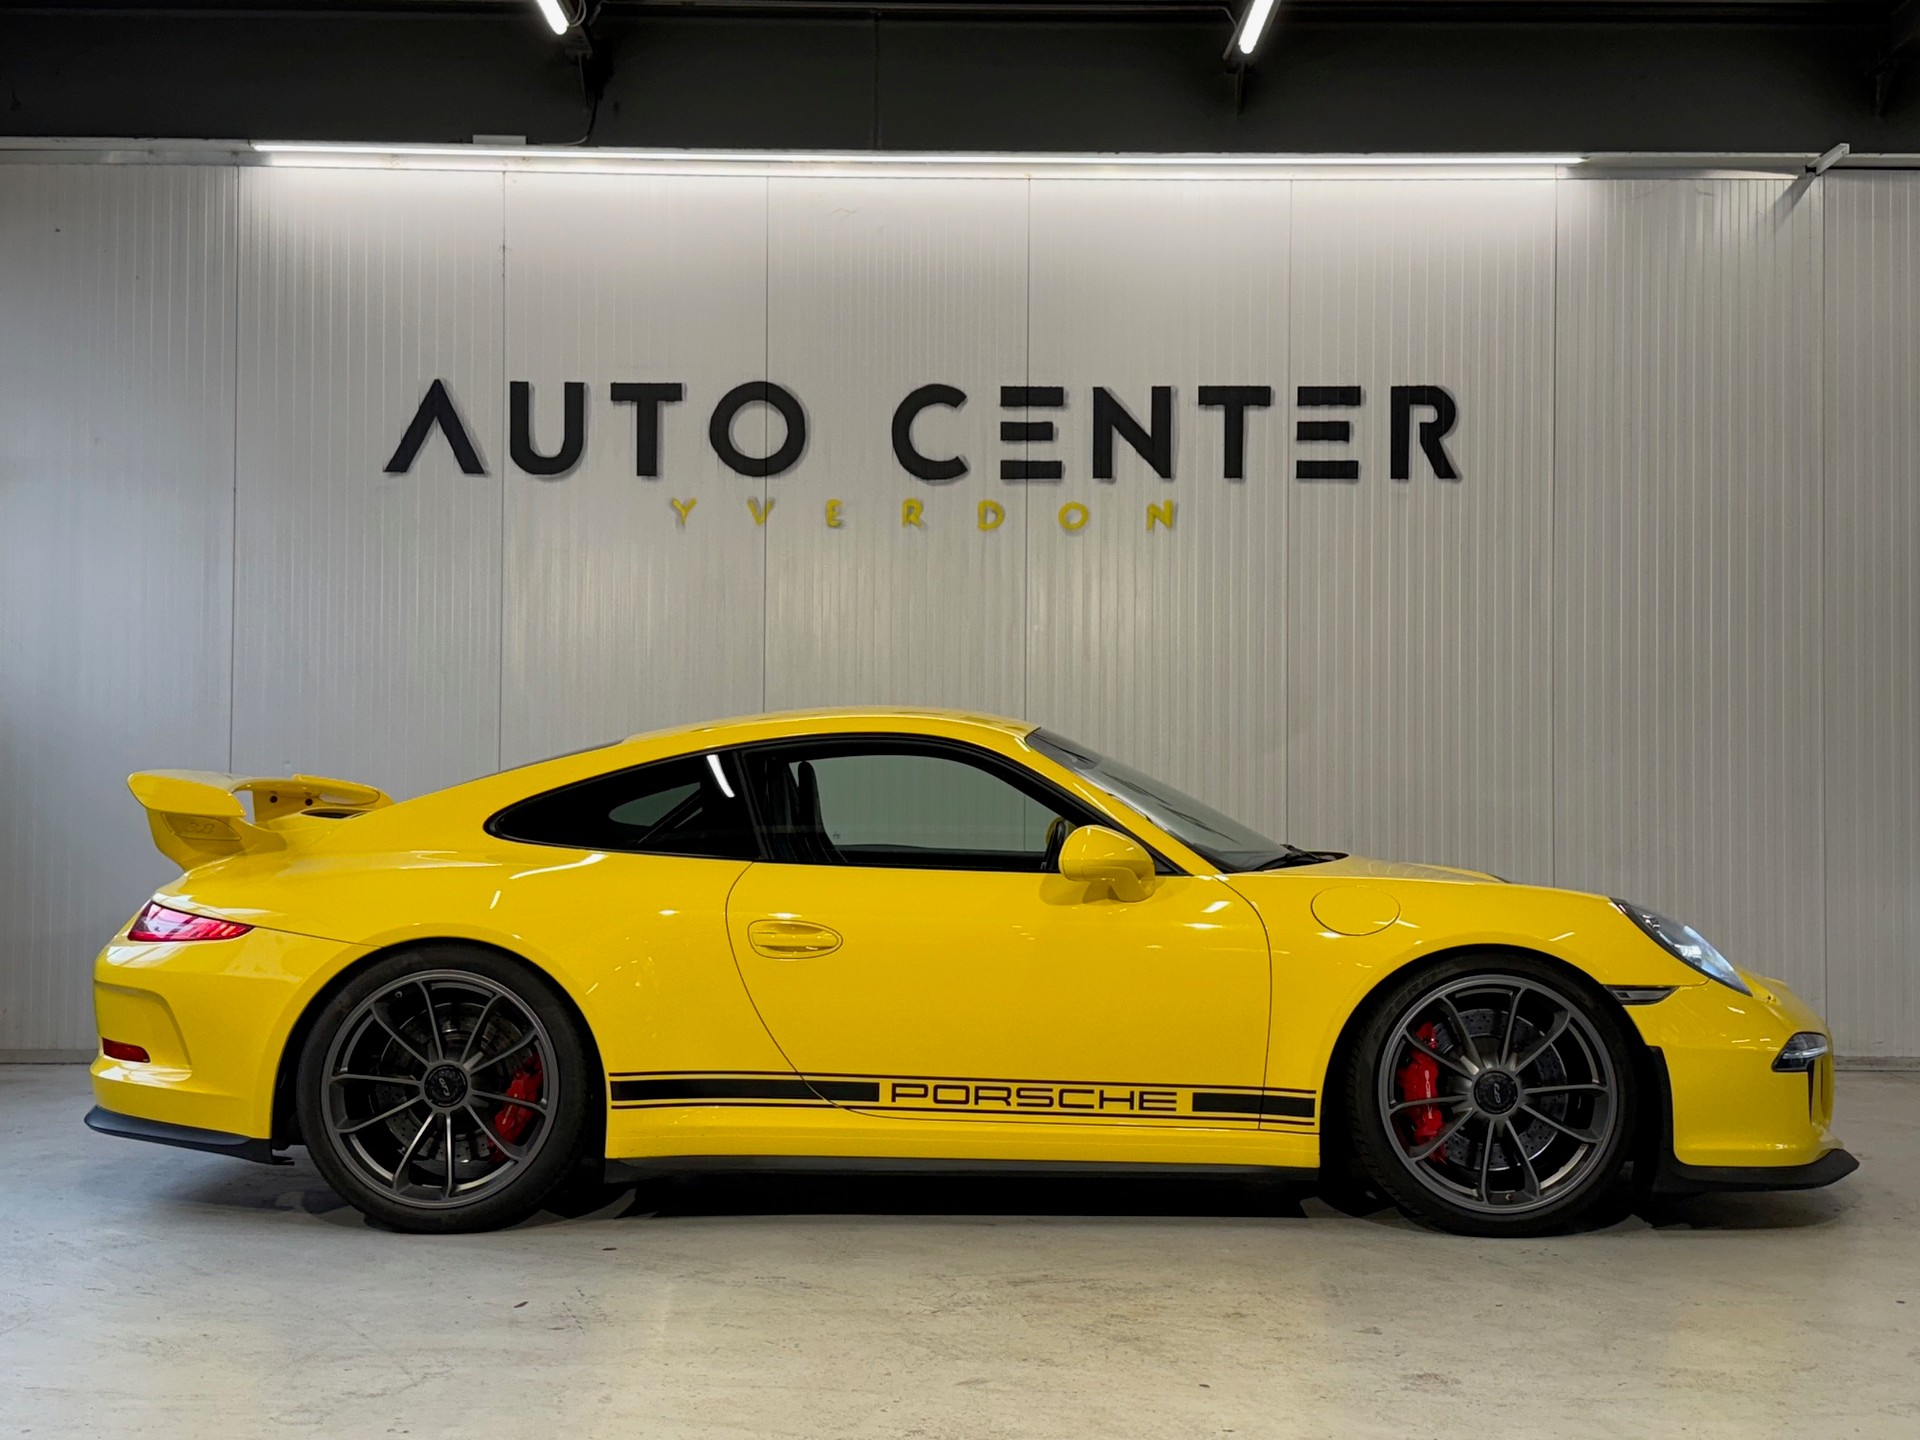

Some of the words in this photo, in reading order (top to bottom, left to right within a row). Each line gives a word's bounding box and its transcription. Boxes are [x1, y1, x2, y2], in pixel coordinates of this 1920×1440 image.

[384, 379, 806, 477] AUTO
[892, 383, 1459, 482] CENTER
[672, 497, 1178, 531] YVERDON
[891, 1082, 1178, 1112] PORSCHE
